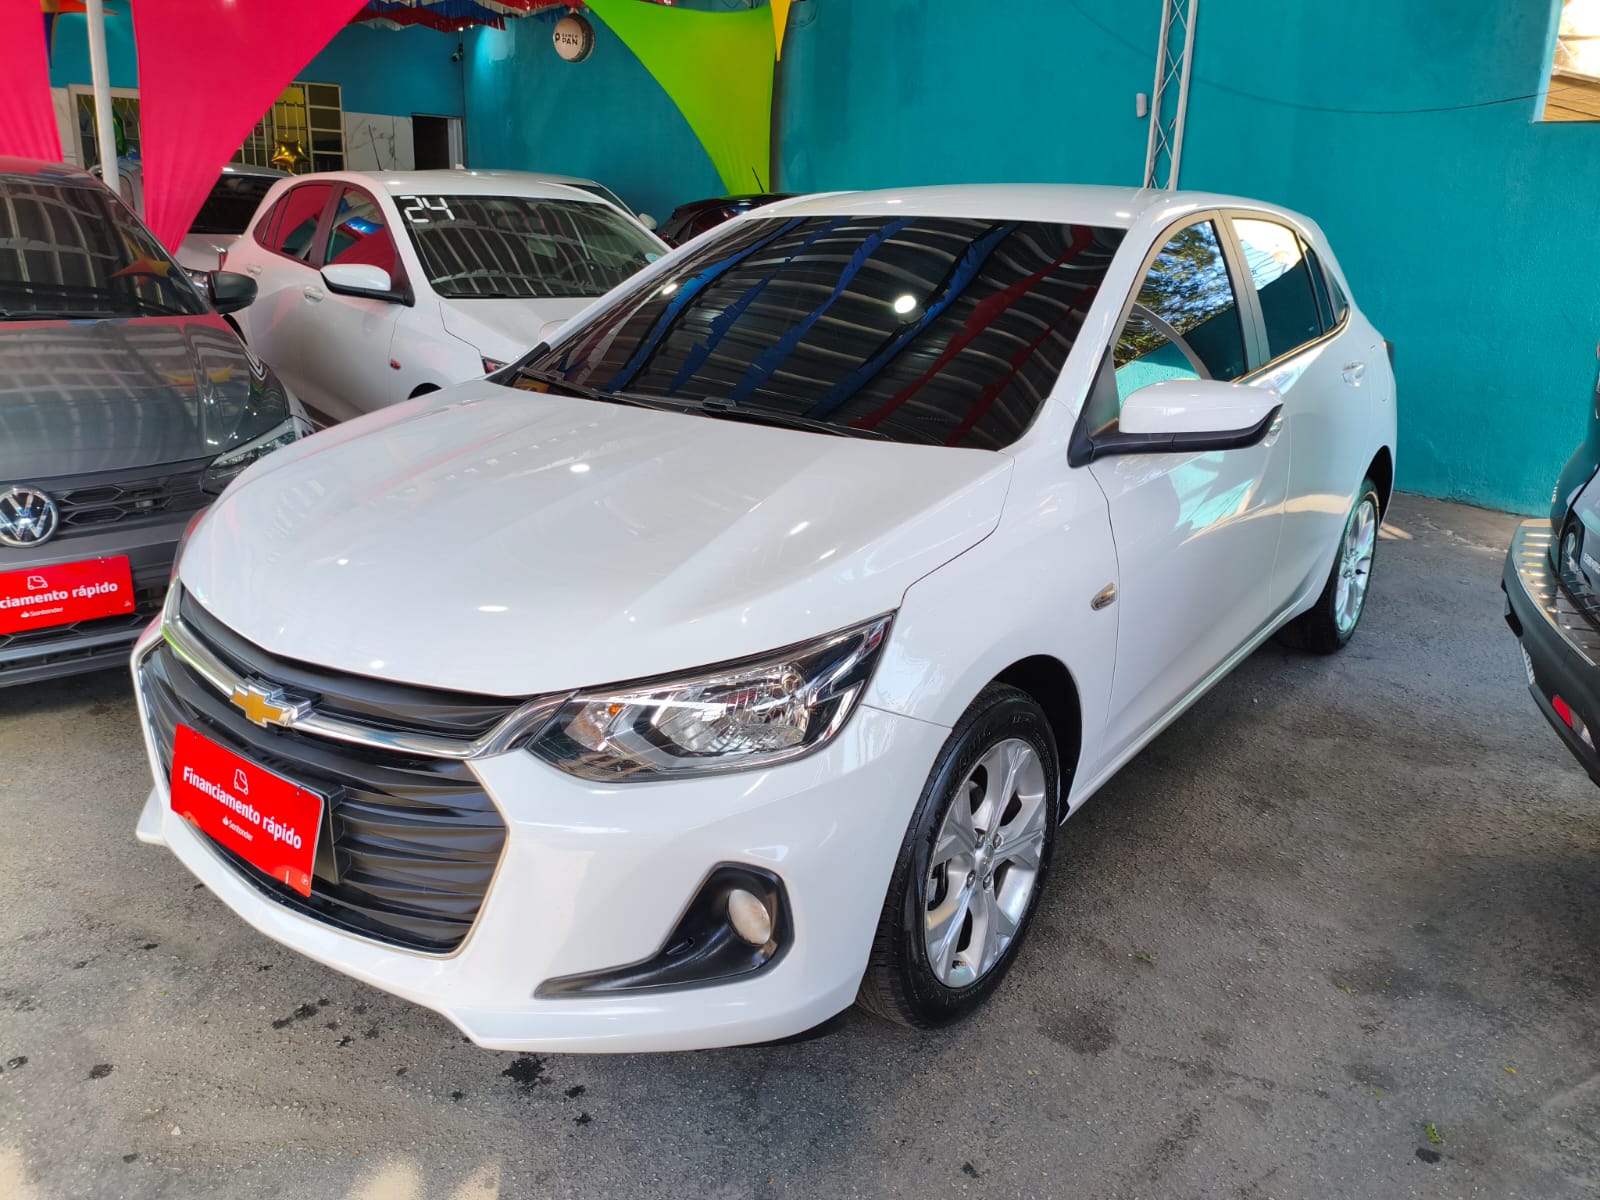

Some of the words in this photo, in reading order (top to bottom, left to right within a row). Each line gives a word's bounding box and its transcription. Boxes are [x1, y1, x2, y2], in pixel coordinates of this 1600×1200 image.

[400, 195, 455, 223] 24
[0, 590, 68, 609] ciamento
[72, 582, 118, 598] rápido
[29, 607, 64, 617] Santander
[183, 766, 260, 825] Financiamento
[262, 816, 302, 849] rápido
[229, 820, 253, 842] Santander
